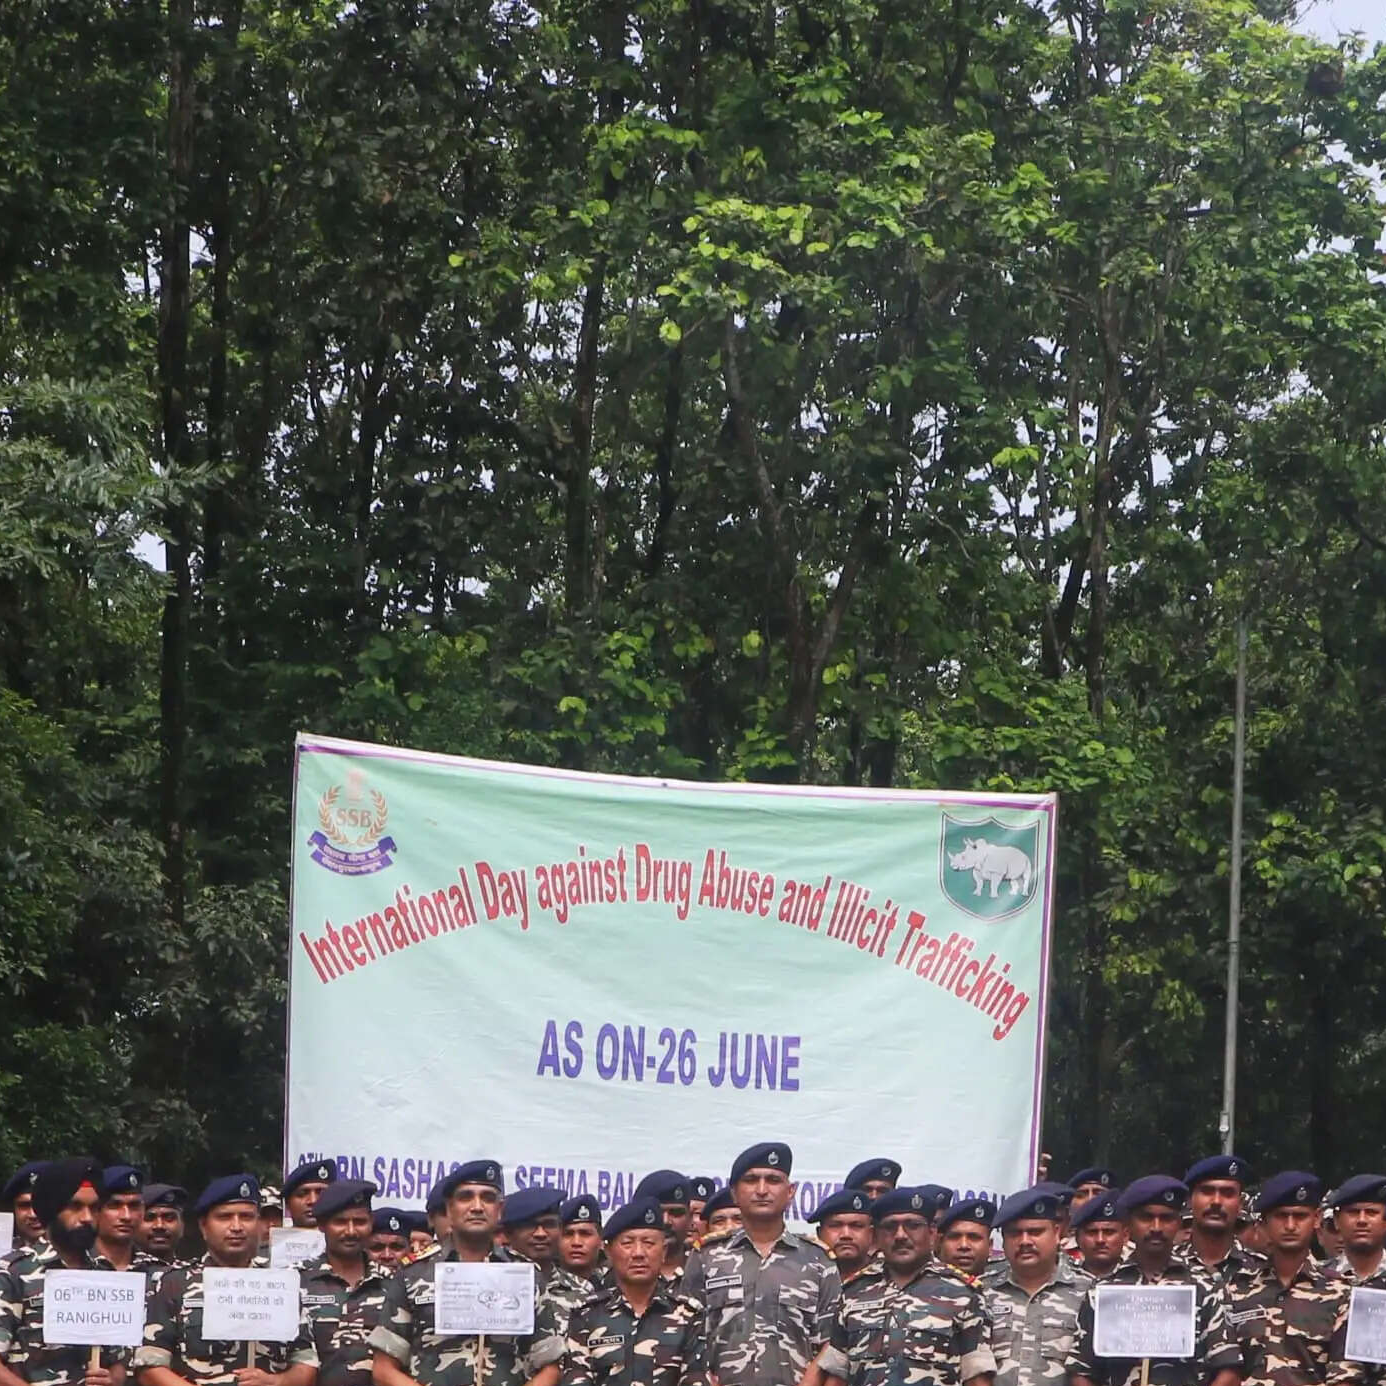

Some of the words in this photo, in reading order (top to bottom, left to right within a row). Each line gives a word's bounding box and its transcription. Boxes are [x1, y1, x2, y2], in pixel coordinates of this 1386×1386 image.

[336, 807, 372, 828] SSB
[299, 866, 478, 985] International
[475, 860, 530, 930] Day
[535, 845, 628, 924] against
[635, 843, 693, 921] Drug
[698, 848, 775, 917] Abuse
[778, 875, 832, 932] and
[826, 880, 900, 958] Illicit
[894, 909, 1031, 1041] Trafficking
[536, 1019, 584, 1079] AS
[595, 1022, 697, 1086] ON-26
[707, 1031, 801, 1091] JUNE
[87, 1288, 107, 1302] BN
[110, 1288, 135, 1302] SSB
[56, 1311, 132, 1325] RANIGHULI
